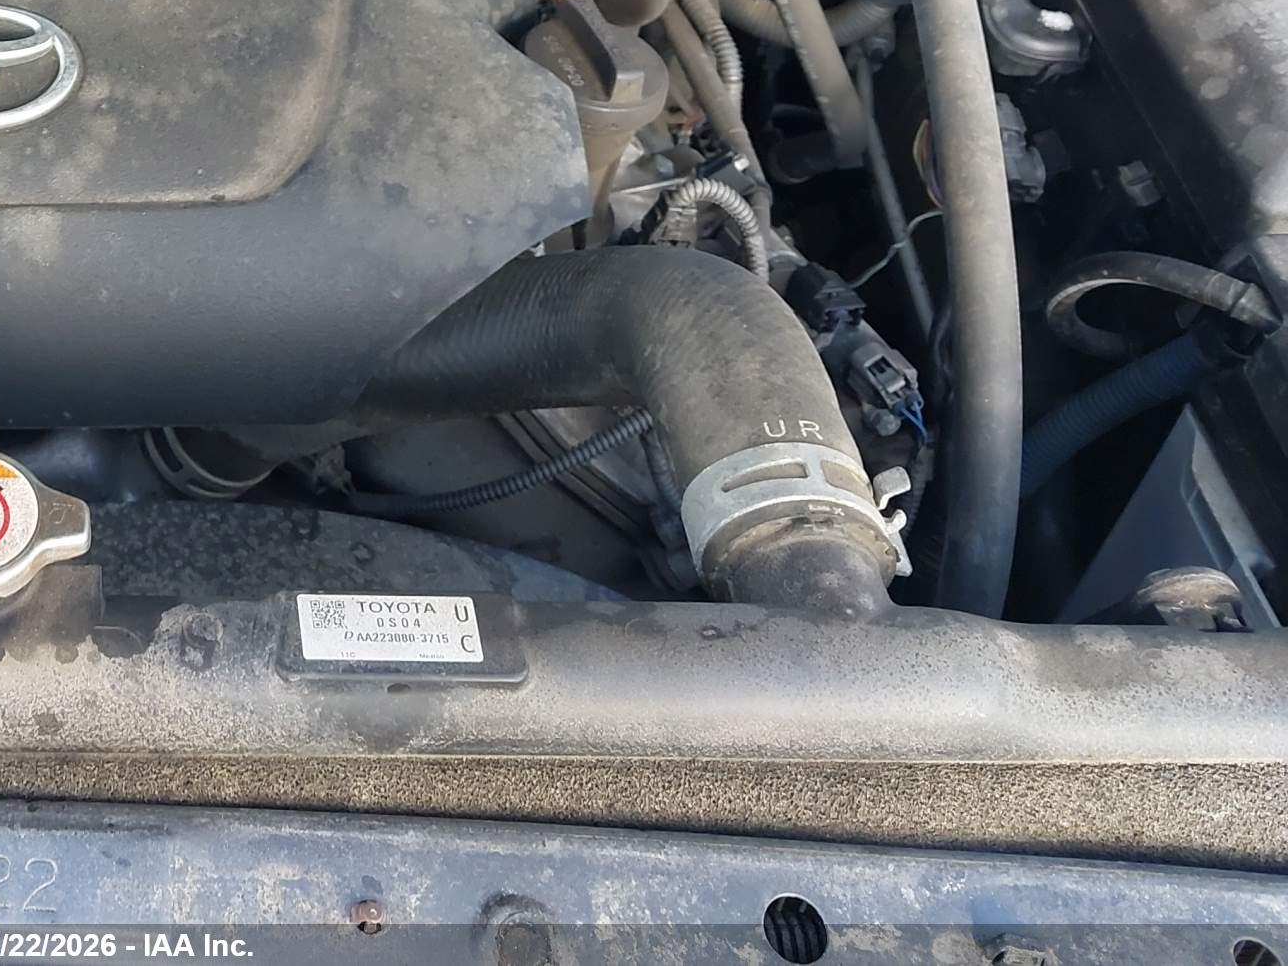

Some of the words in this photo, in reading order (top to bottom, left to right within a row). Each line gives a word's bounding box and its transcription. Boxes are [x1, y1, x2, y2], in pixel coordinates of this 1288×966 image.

[356, 601, 437, 614] TOYOTA
[454, 603, 469, 623] U
[460, 634, 475, 653] C
